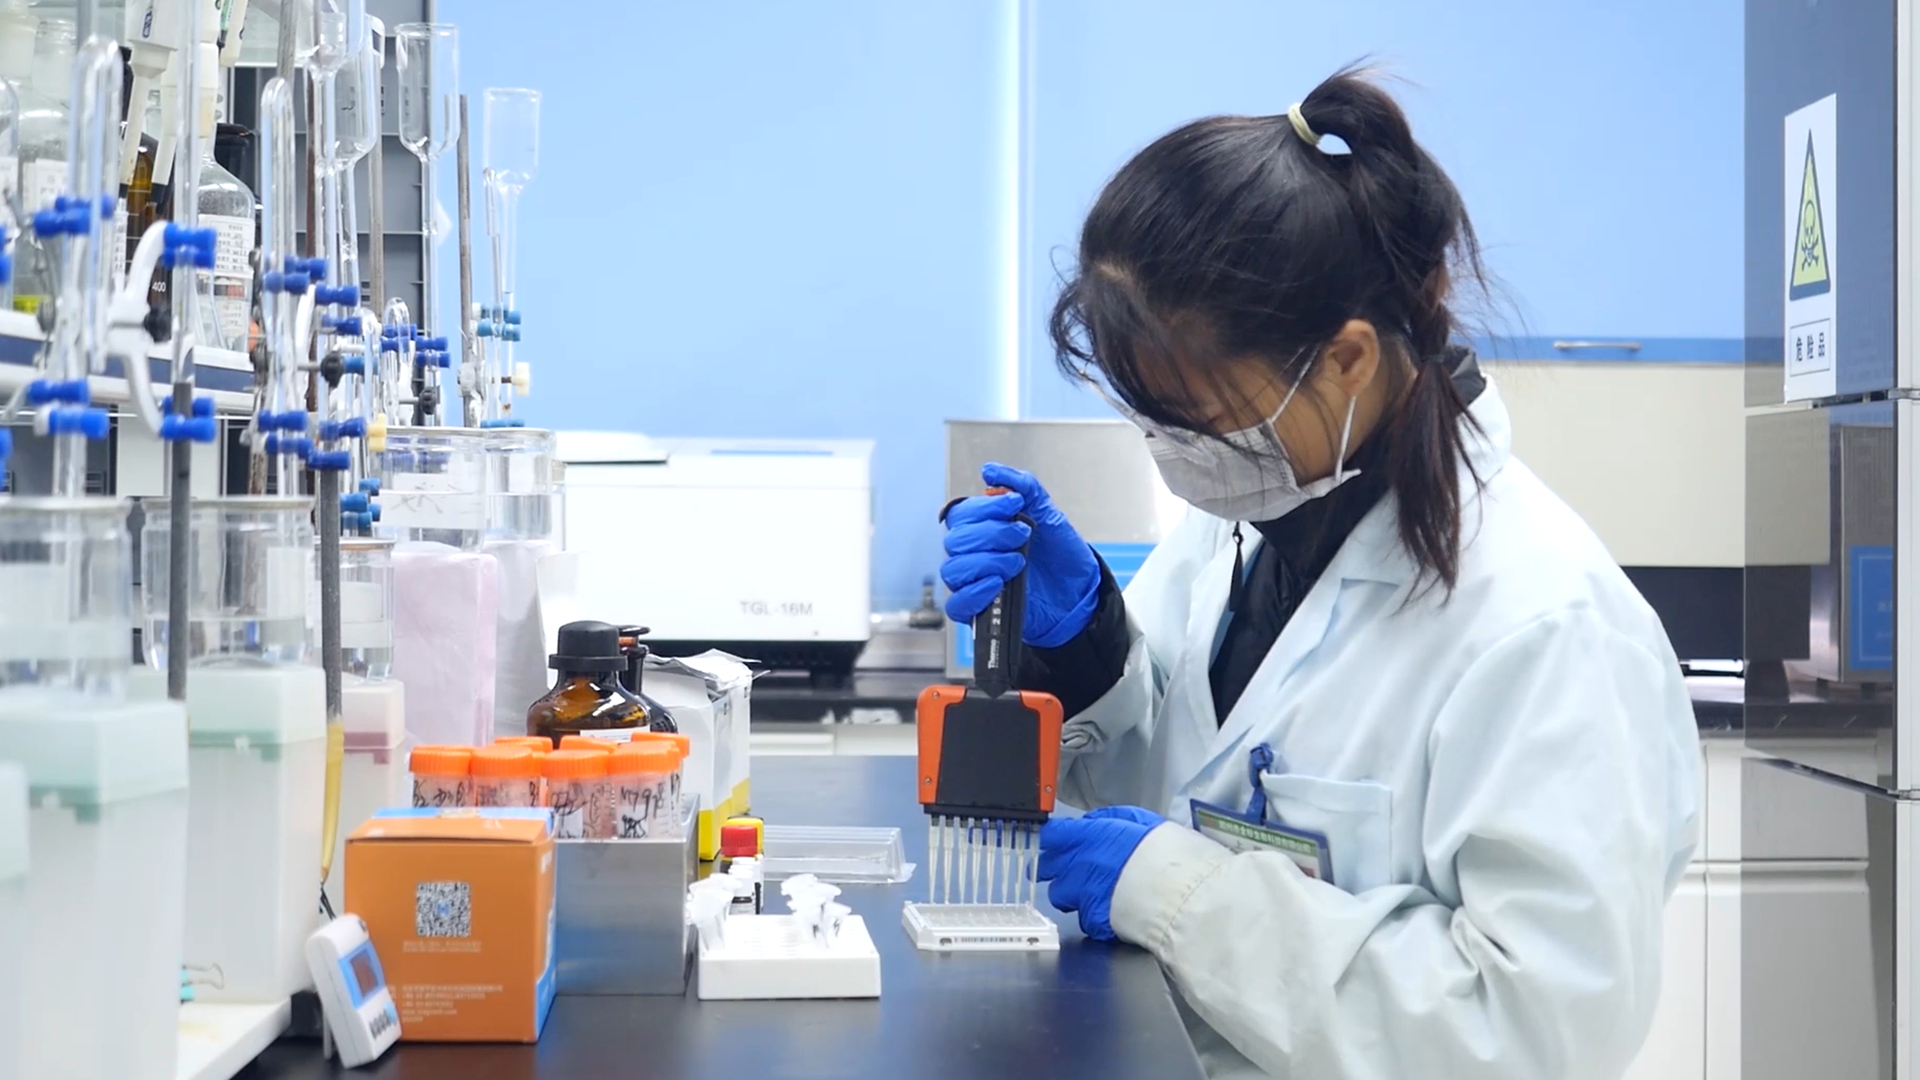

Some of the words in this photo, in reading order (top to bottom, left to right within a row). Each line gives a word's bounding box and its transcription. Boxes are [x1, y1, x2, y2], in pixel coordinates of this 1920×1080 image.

[152, 281, 166, 292] 400
[1796, 332, 1825, 361] 危险品
[740, 602, 813, 616] TGL-16M
